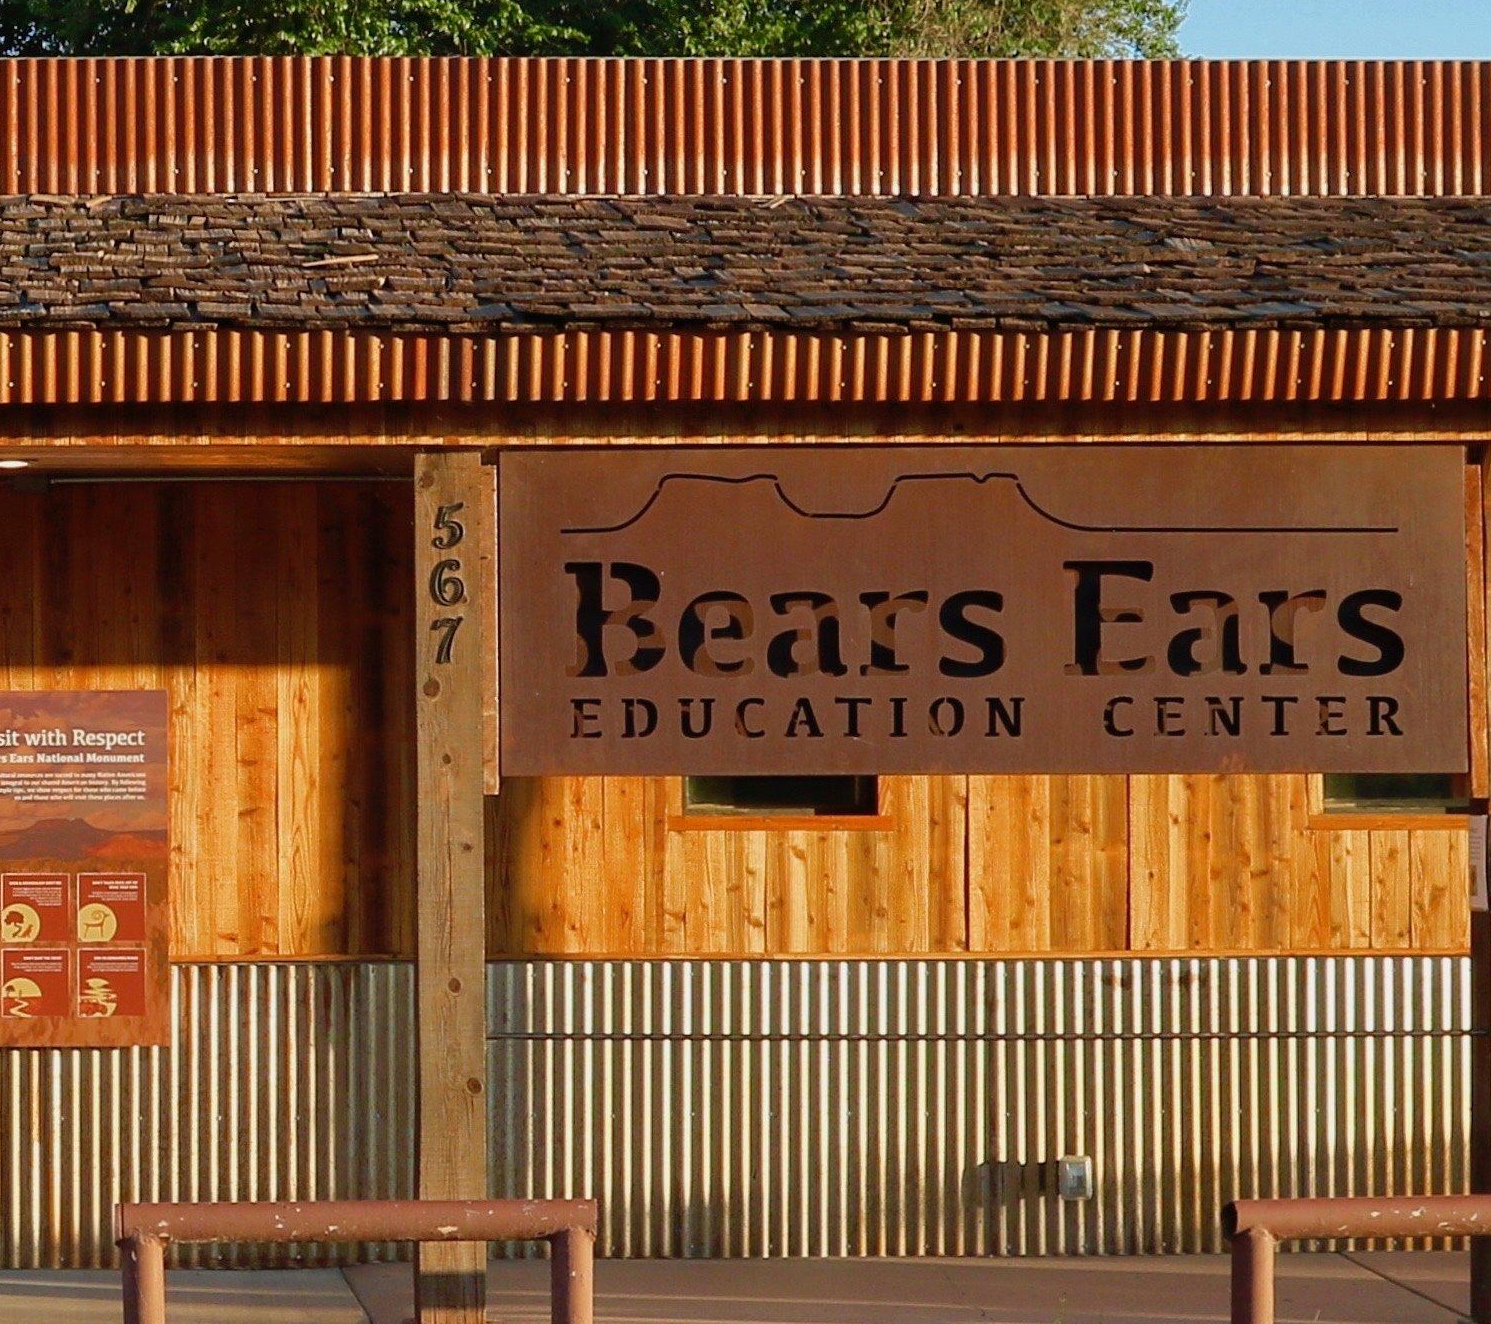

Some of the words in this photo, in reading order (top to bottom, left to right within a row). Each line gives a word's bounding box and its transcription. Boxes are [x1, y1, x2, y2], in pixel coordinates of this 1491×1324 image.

[563, 559, 1008, 678] Bears
[1062, 559, 1406, 678] Ears
[569, 695, 1026, 739] EDUCATION
[1103, 695, 1405, 738] CENTER
[24, 729, 67, 746] with
[72, 729, 145, 750] Respect
[10, 753, 34, 763] Ears
[37, 753, 84, 763] National
[86, 753, 144, 763] Monument
